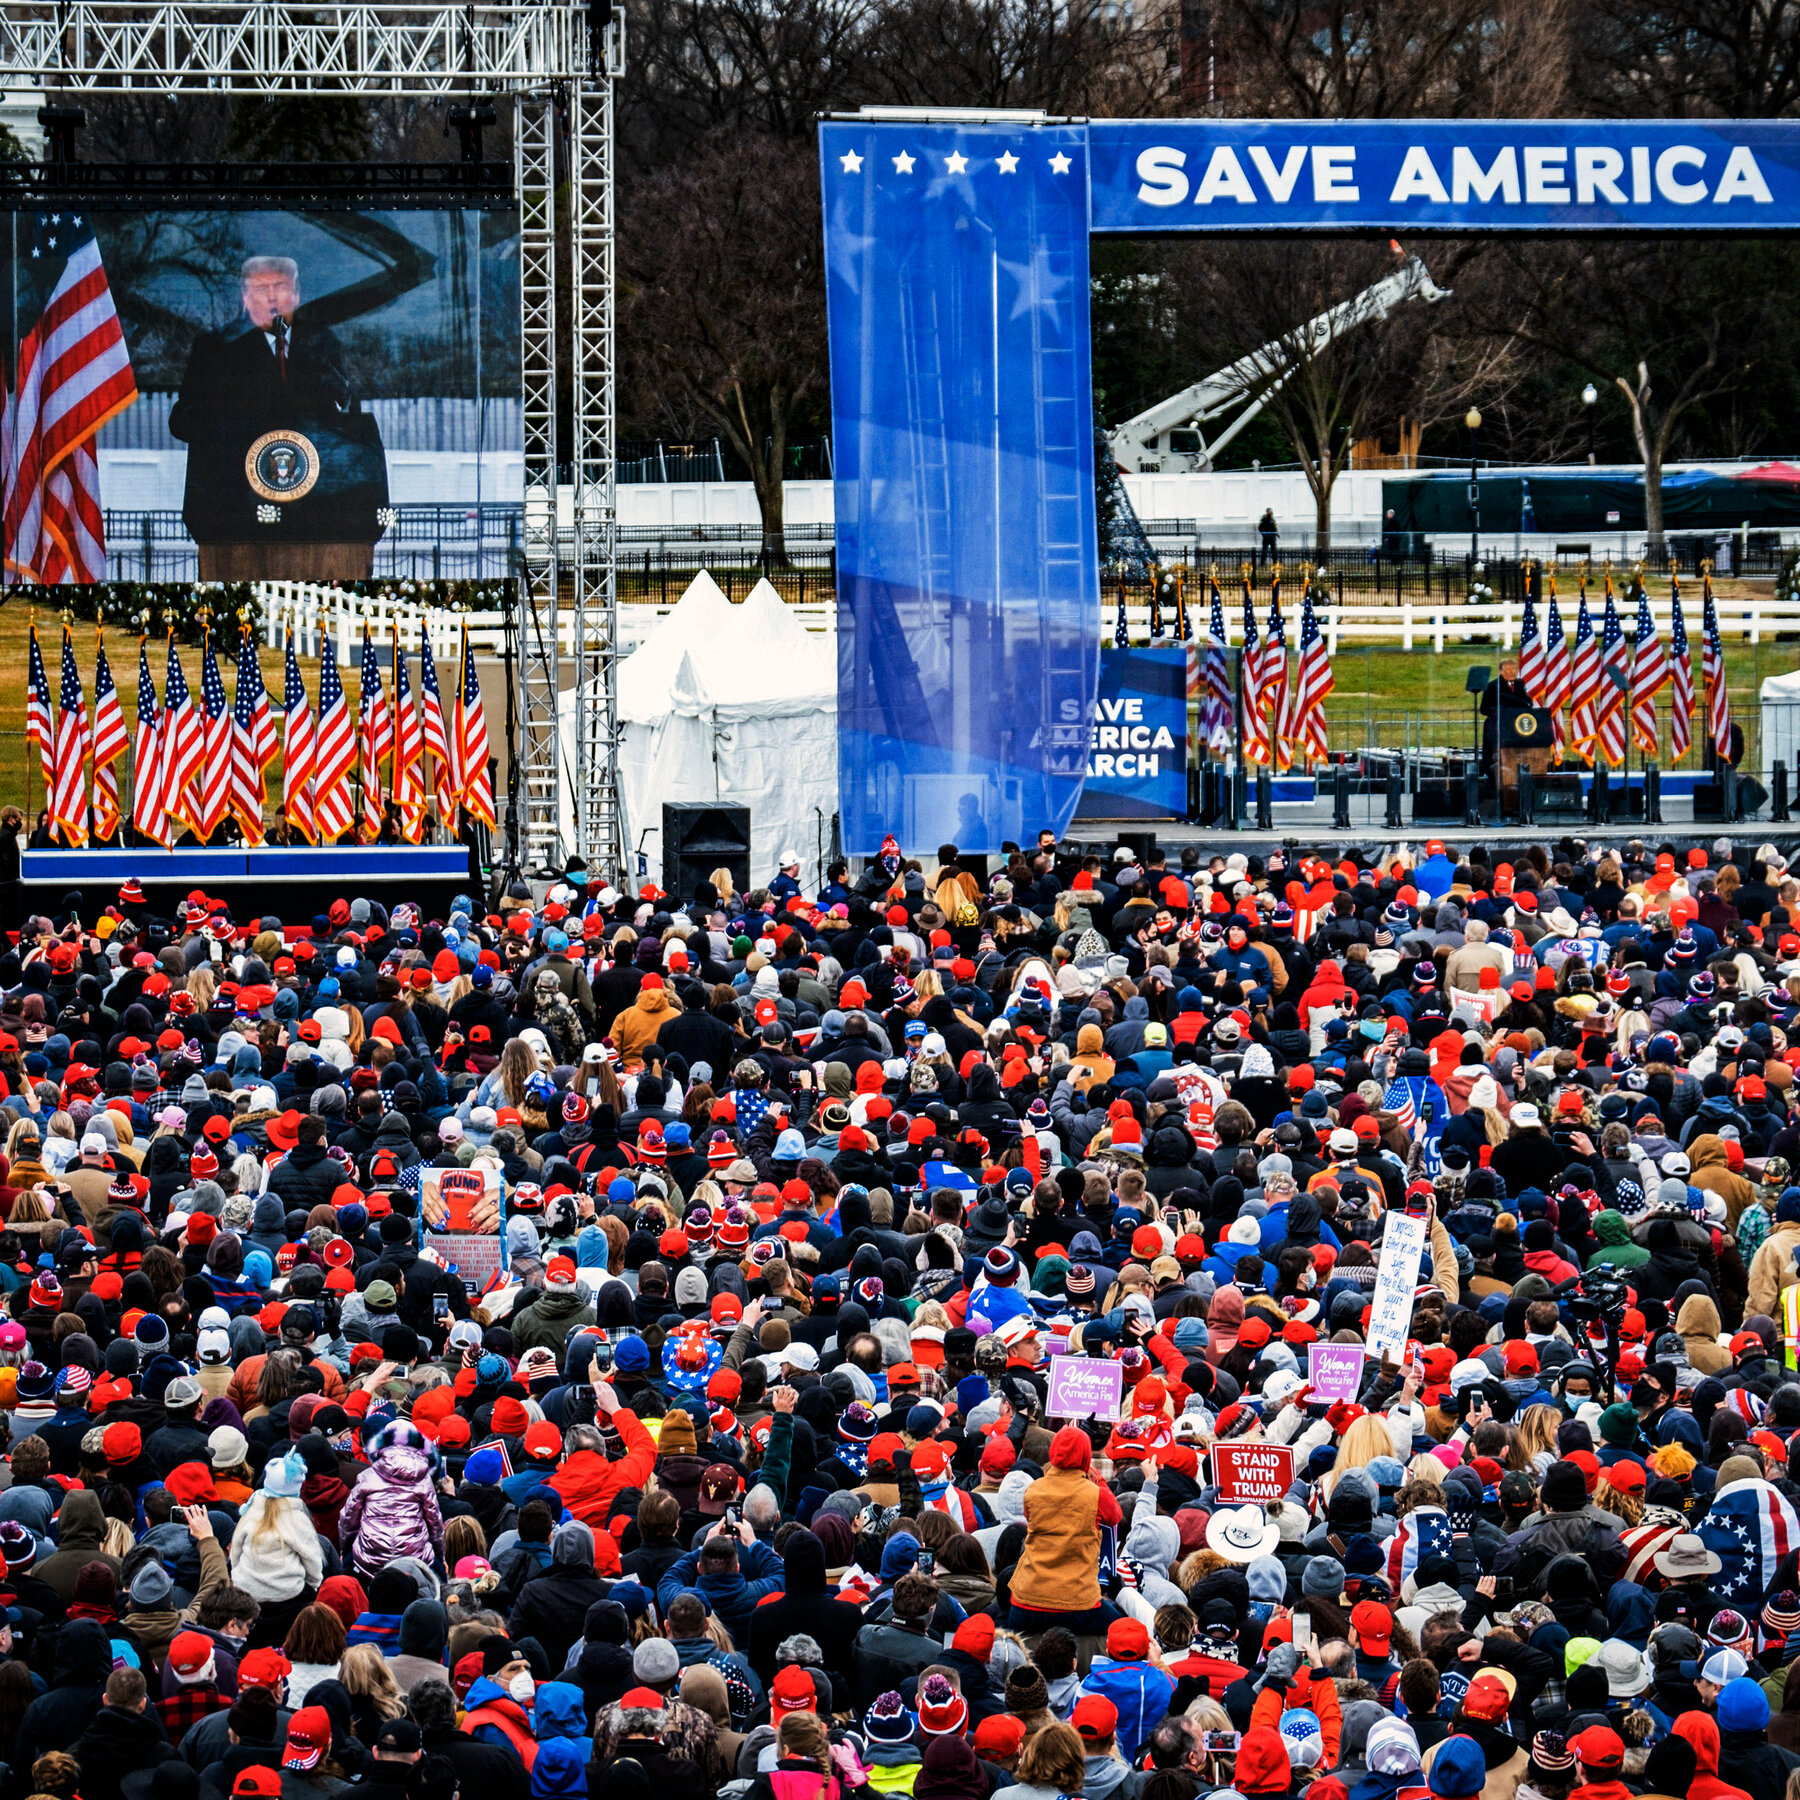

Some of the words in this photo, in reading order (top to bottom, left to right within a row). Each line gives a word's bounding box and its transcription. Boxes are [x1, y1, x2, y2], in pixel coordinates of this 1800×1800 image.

[1136, 145, 1360, 205] SAVE
[1389, 145, 1775, 205] AMERICA
[248, 432, 280, 465] PRESIDENT
[301, 440, 317, 469] UNITED
[1060, 698, 1144, 721] SAVE
[1029, 726, 1176, 749] AMERICA
[1043, 754, 1159, 777] MARCH
[442, 1175, 480, 1190] TRUMP
[1318, 1351, 1356, 1371] Women
[1063, 1364, 1115, 1386] Women
[1320, 1375, 1343, 1385] America
[1343, 1375, 1355, 1385] First
[1064, 1388, 1099, 1400] America
[1100, 1390, 1114, 1401] First
[1231, 1451, 1280, 1467] STAND
[1238, 1467, 1275, 1482] WITH
[1232, 1481, 1282, 1497] TRUMP
[792, 1696, 810, 1704] AMERICA
